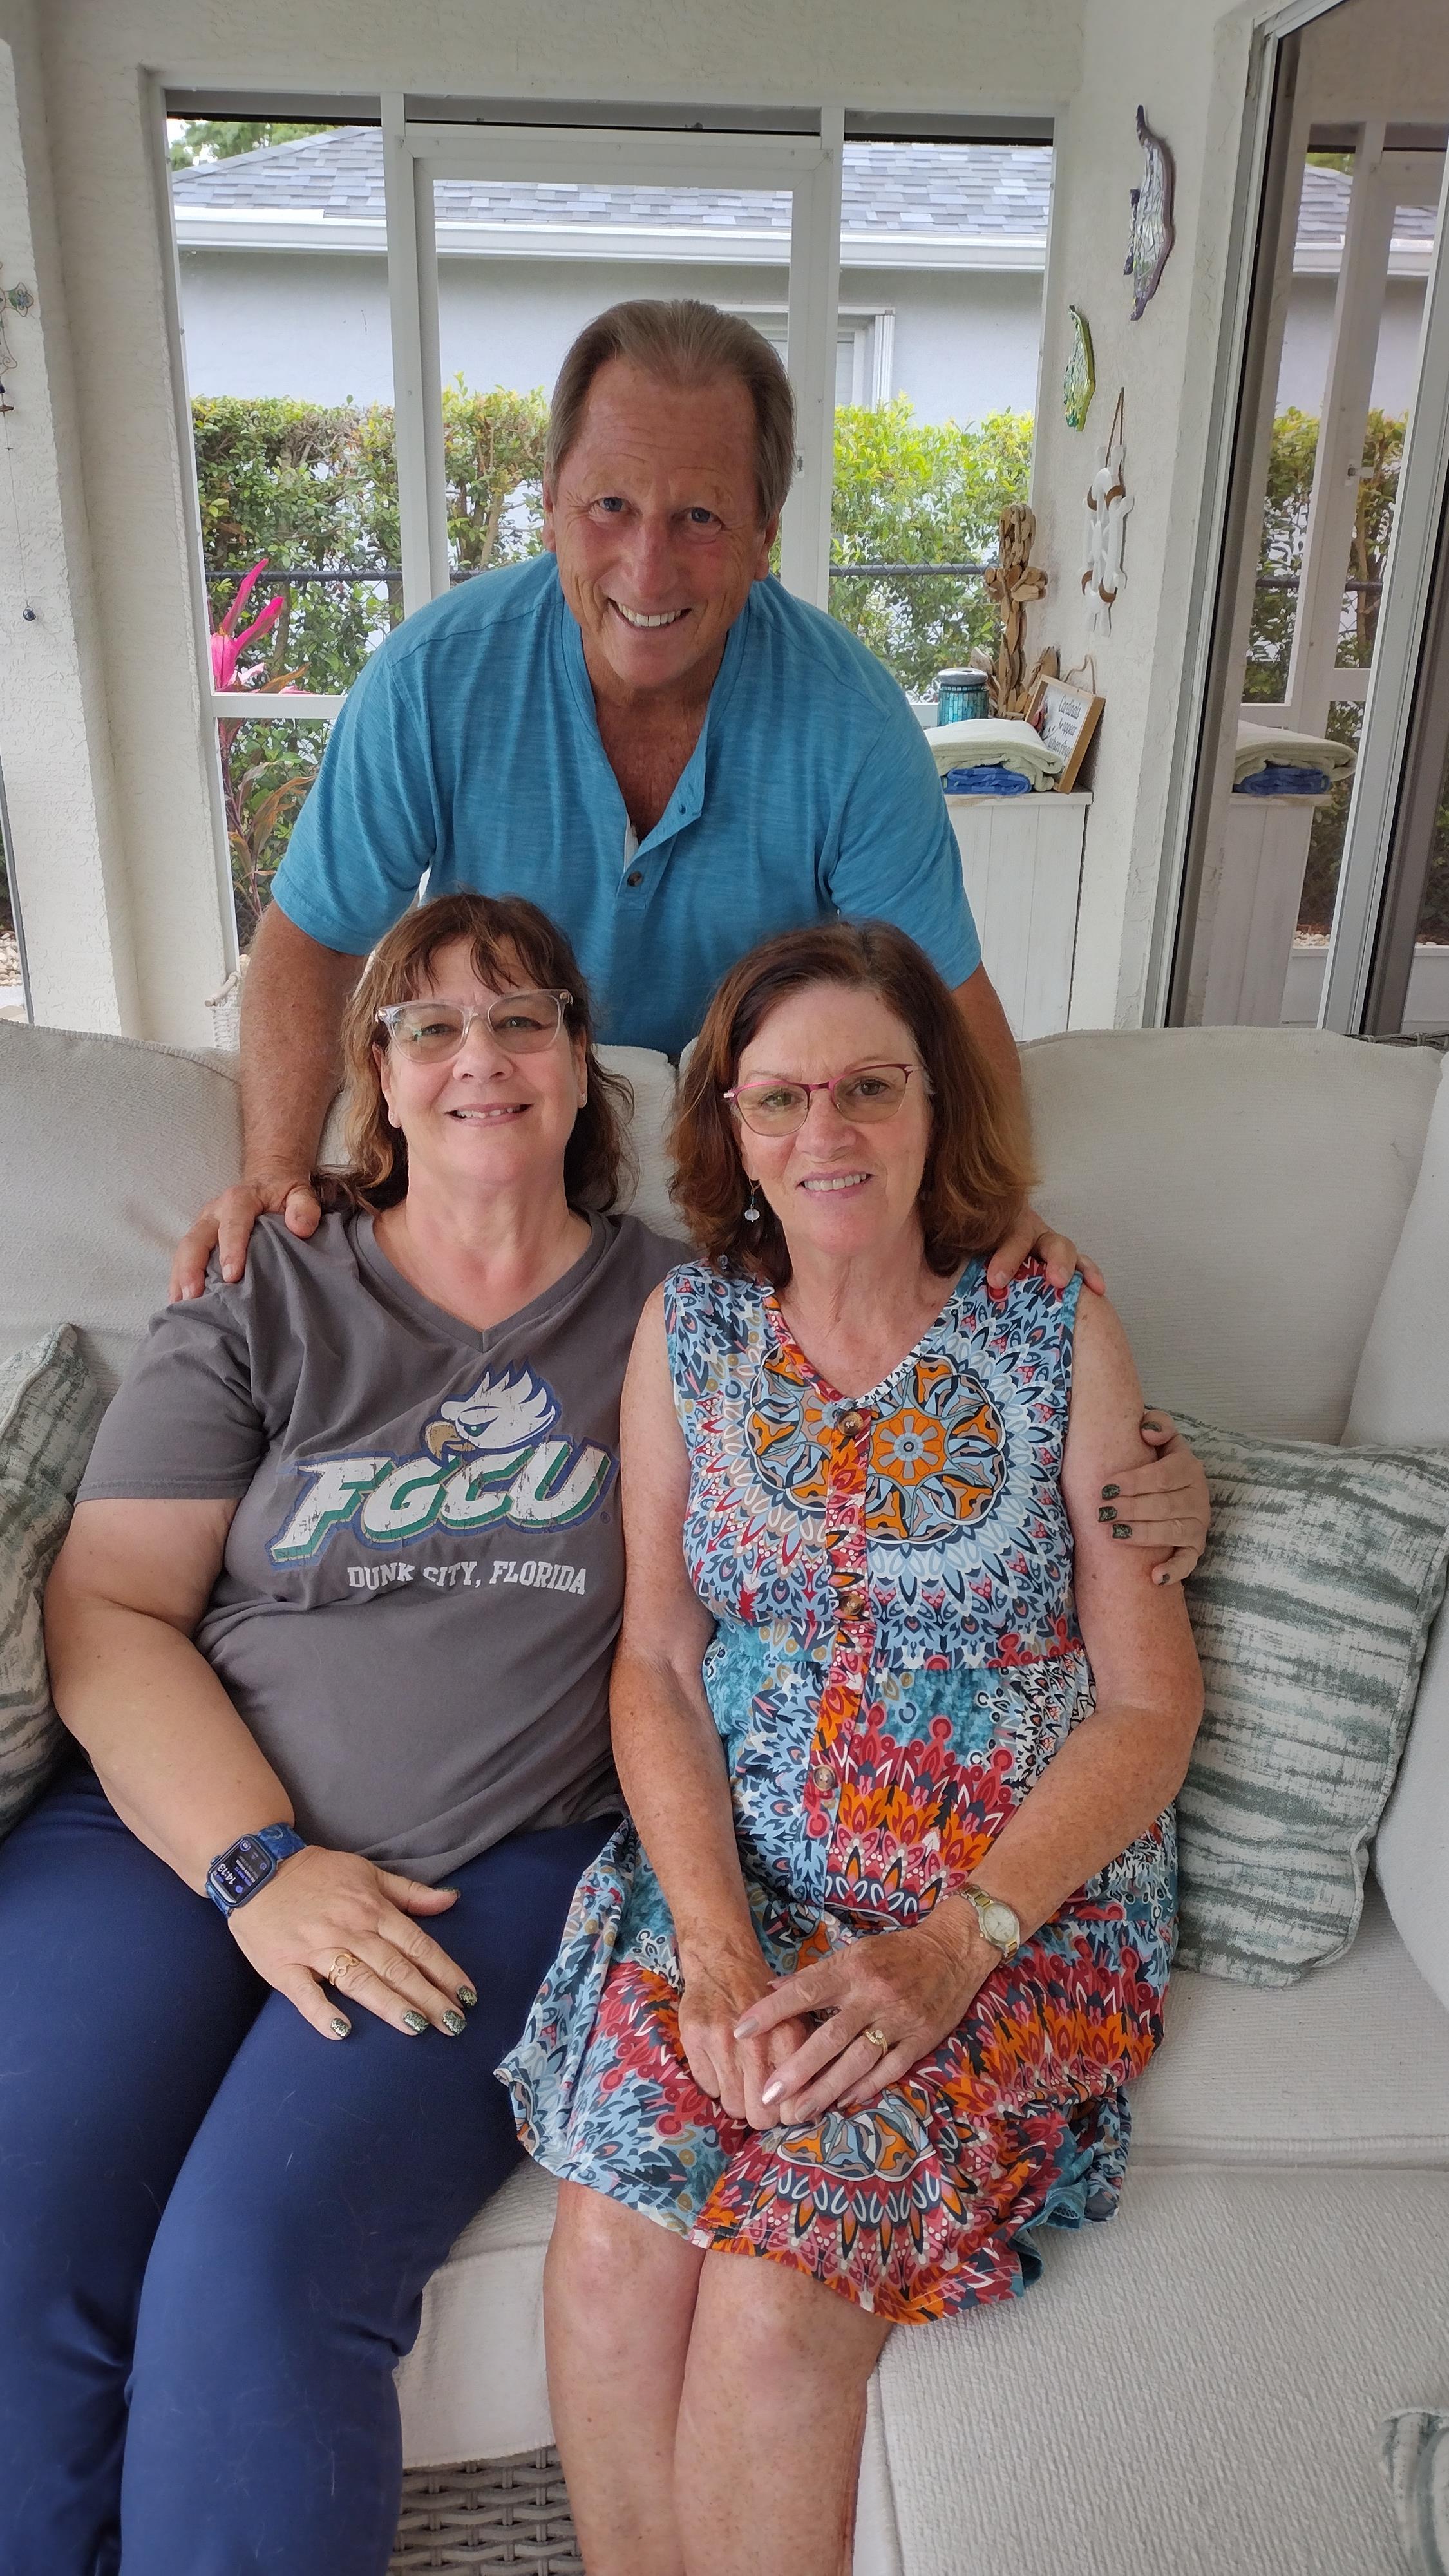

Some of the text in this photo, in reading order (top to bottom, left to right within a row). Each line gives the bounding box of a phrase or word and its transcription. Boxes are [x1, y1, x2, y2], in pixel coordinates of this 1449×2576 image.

[269, 1439, 613, 1563] FGCU
[347, 1560, 587, 1595] DUNK CITY, FLORIDA
[218, 1863, 236, 1885] 14:13
